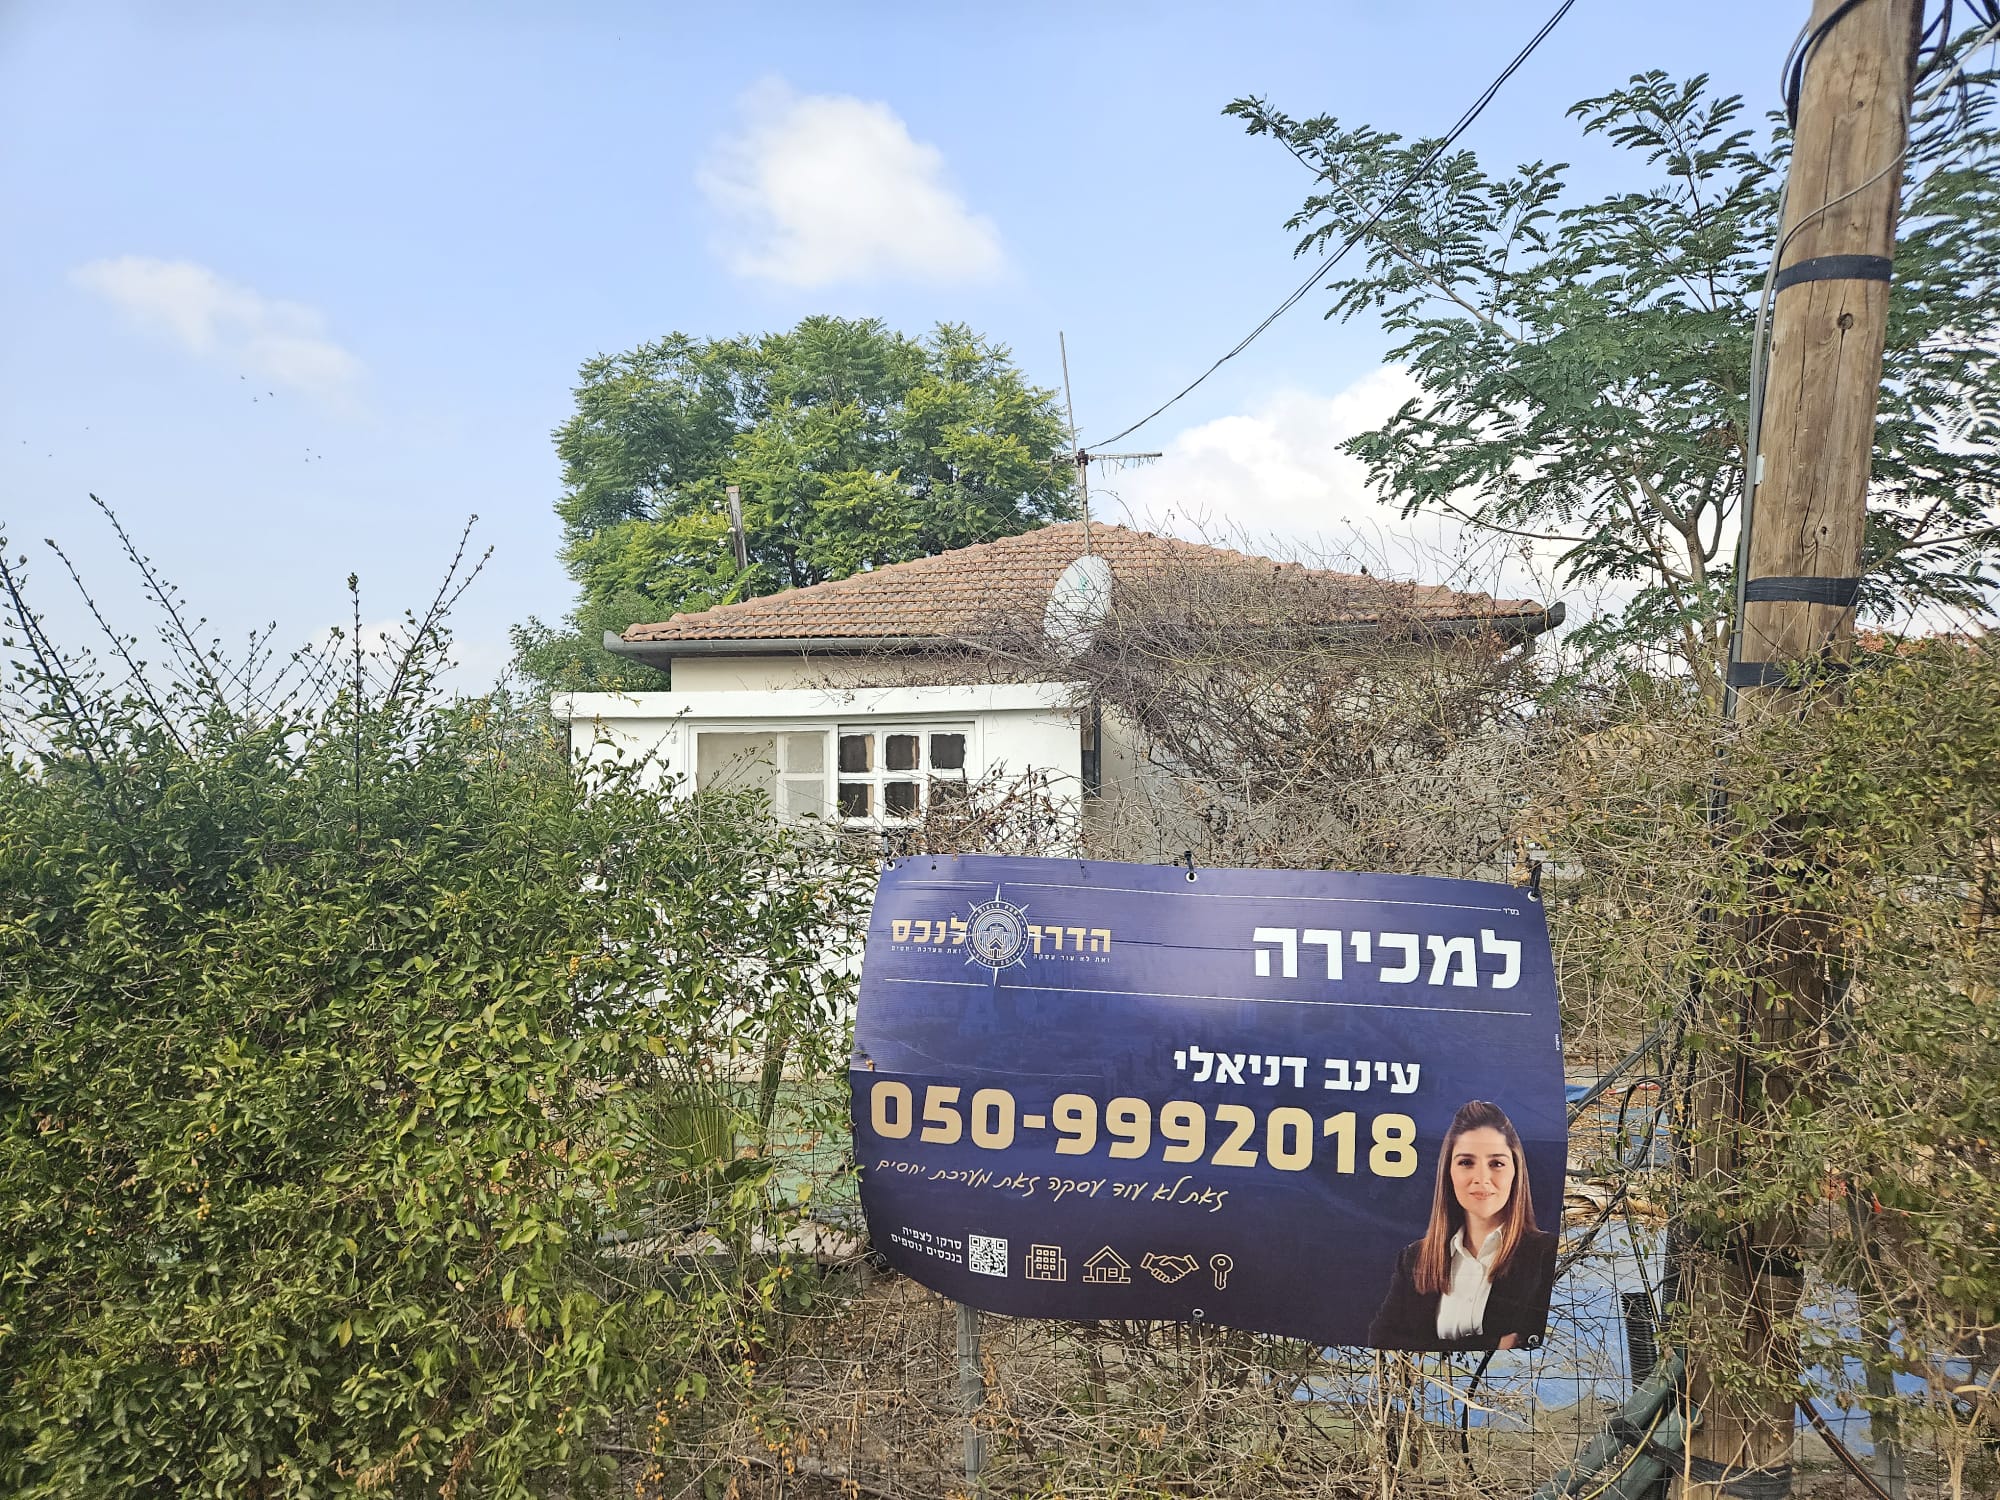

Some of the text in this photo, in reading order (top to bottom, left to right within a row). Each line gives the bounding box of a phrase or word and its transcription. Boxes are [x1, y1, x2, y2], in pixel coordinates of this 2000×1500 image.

[891, 918, 1111, 954] הדרך לנכס
[1252, 927, 1522, 989] למכירה
[1173, 1045, 1421, 1095] עינב דניאלי
[869, 1081, 1418, 1179] 050-9992018
[875, 1159, 1230, 1213] זאת לא עוד עסקה זאת מערכת יחסים
[890, 1233, 963, 1264] בנכסים נוספים
[901, 1226, 962, 1250] סרקו לצפיה
